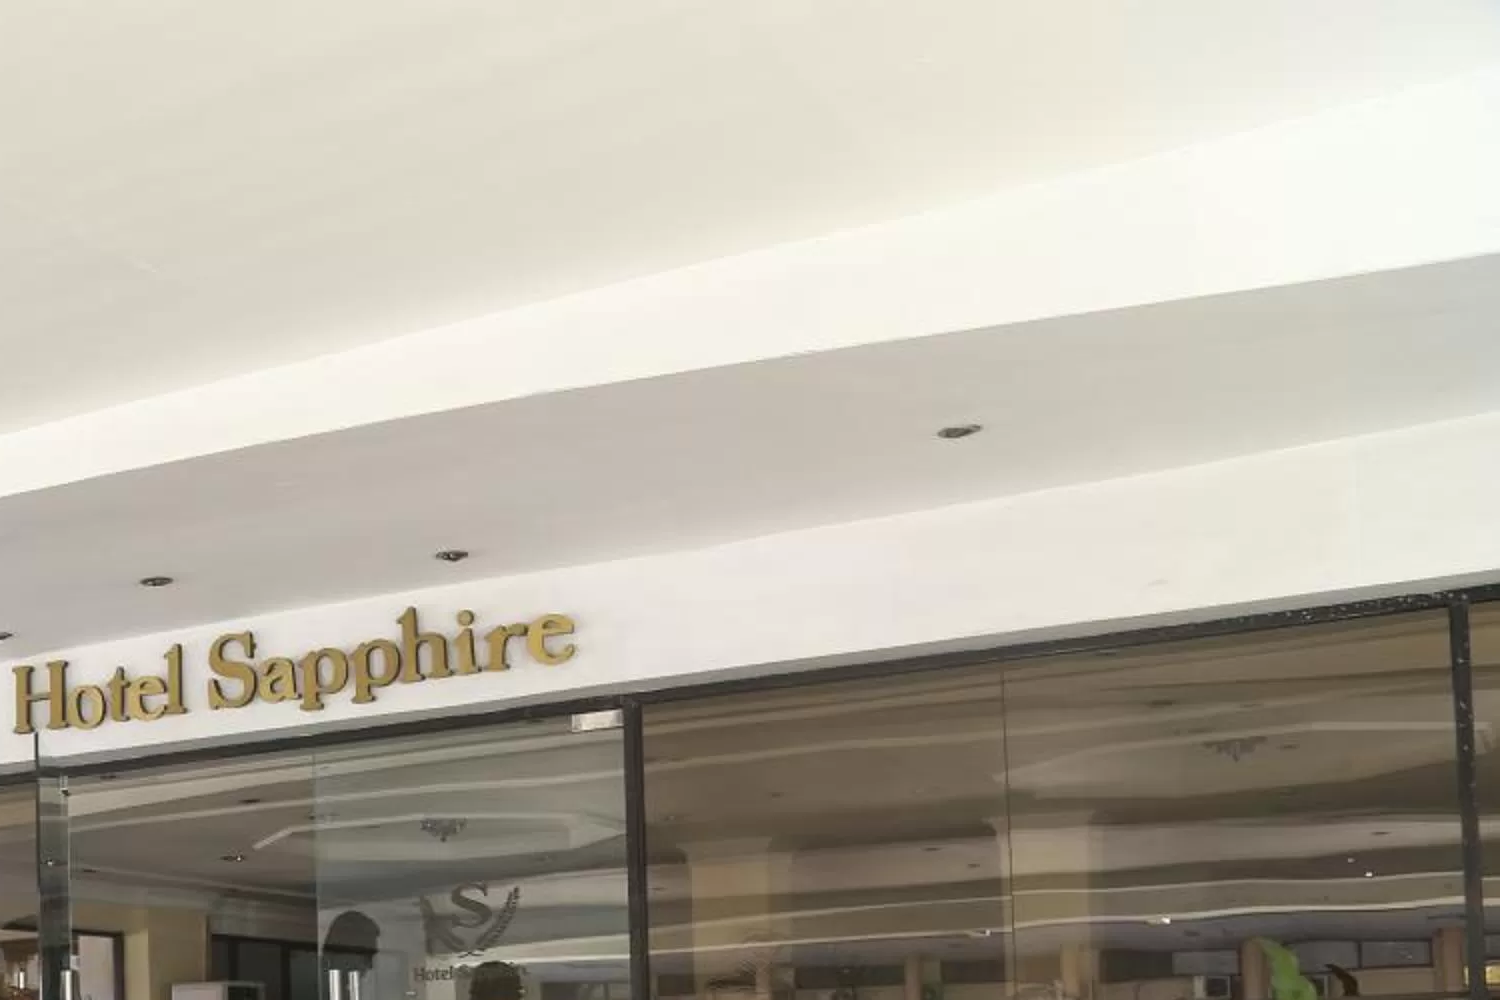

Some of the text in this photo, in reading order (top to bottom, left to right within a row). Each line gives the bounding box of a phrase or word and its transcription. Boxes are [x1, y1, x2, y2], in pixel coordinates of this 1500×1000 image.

[12, 607, 576, 734] Hotel Sapphire
[452, 882, 493, 928] S
[414, 965, 453, 982] Hotel
